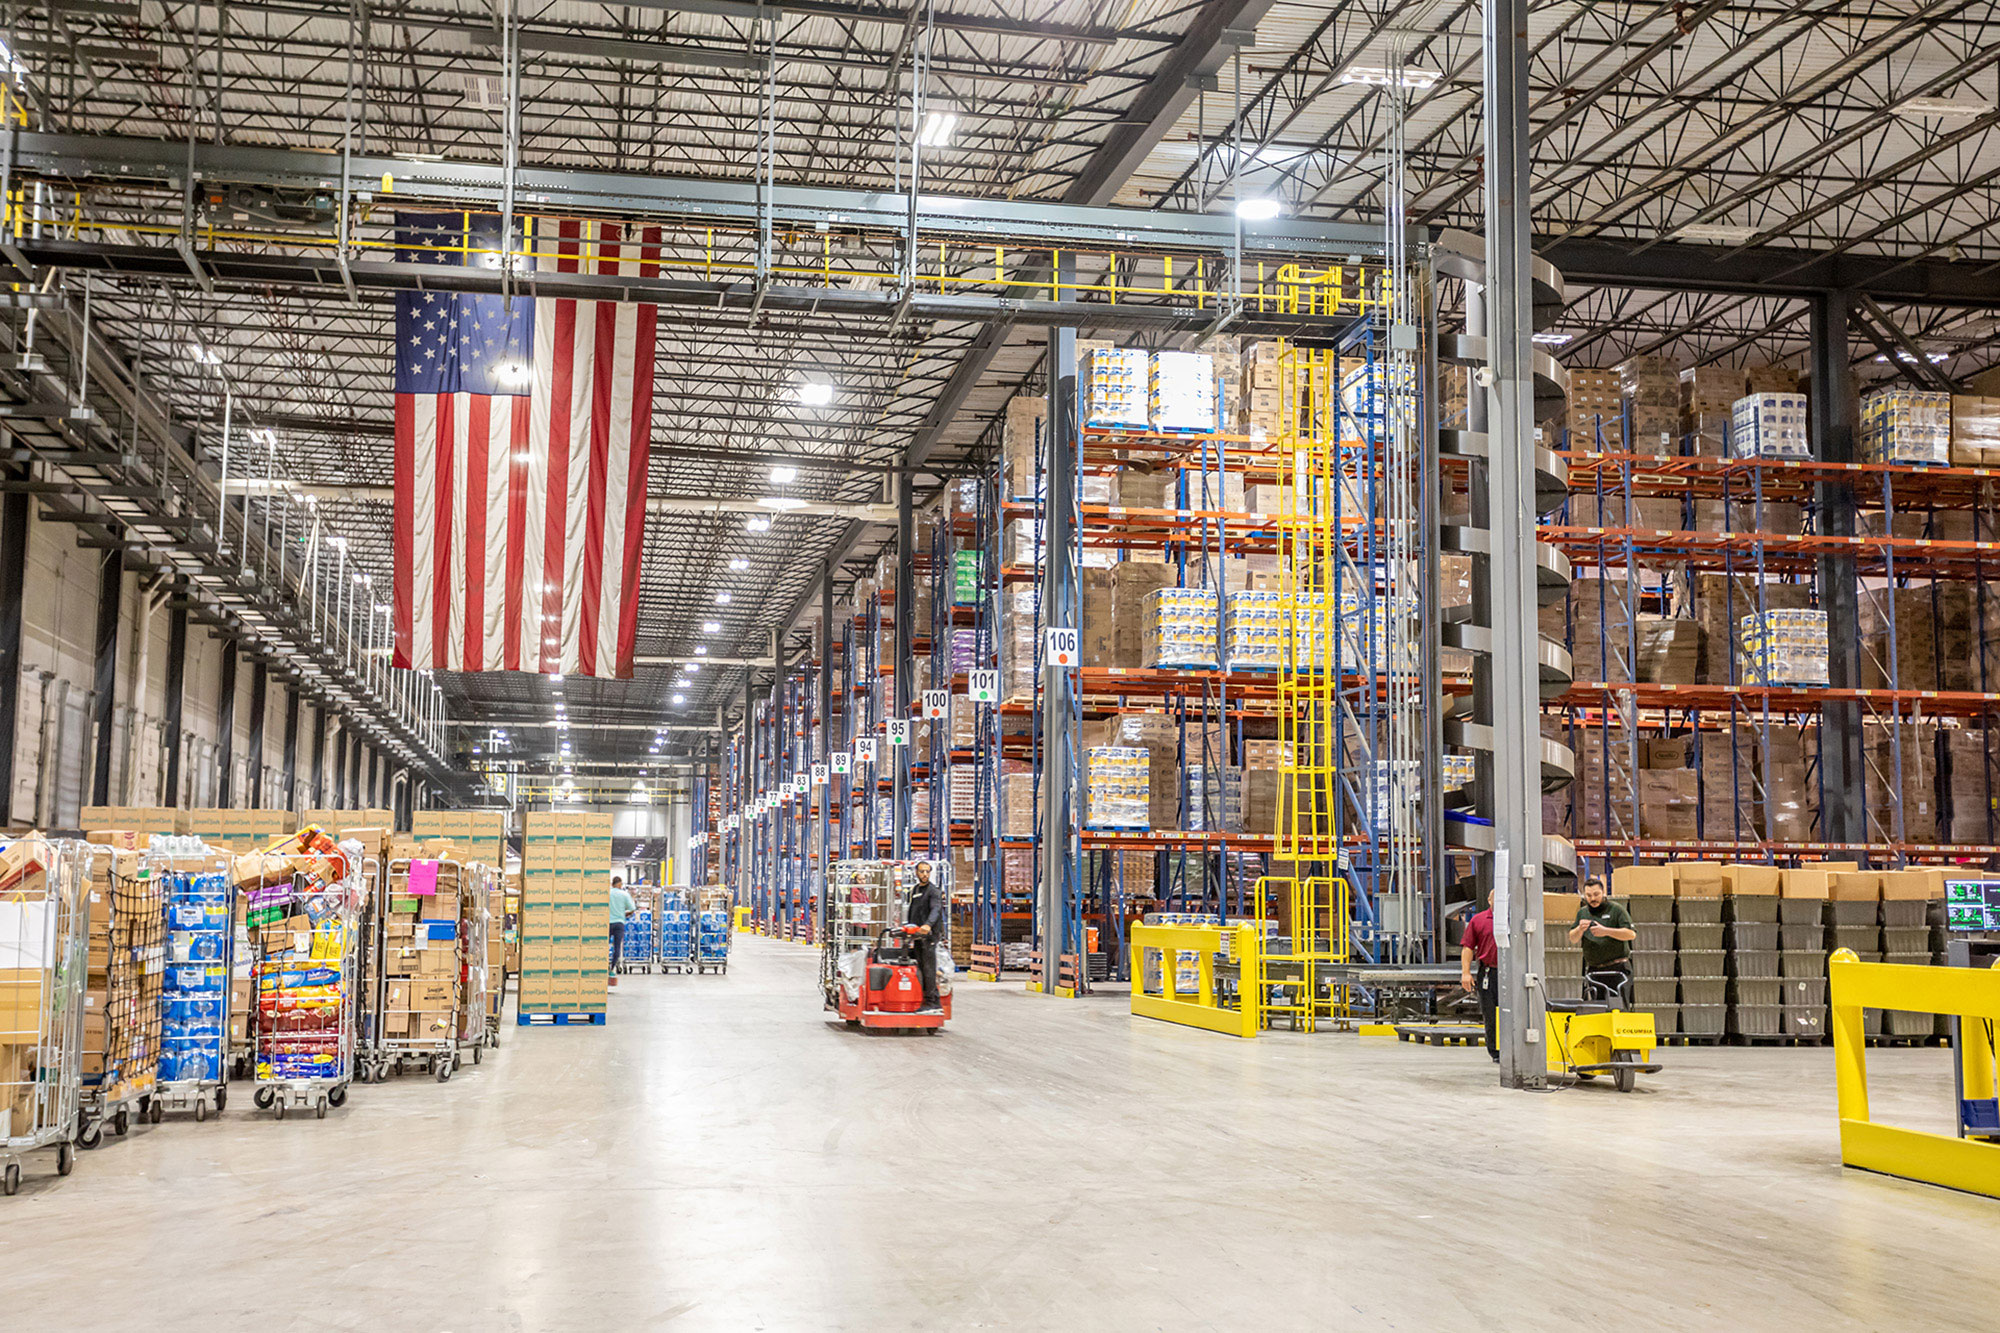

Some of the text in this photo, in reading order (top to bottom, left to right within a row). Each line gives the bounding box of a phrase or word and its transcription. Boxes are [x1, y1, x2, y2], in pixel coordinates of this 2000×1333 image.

[1050, 632, 1075, 651] 106
[971, 673, 994, 689] 101
[925, 693, 946, 707] 100
[892, 722, 904, 735] 95
[860, 741, 871, 752] 94
[835, 755, 846, 765] 89
[815, 767, 825, 776] 88
[797, 776, 806, 785] 83
[783, 785, 791, 793] 82
